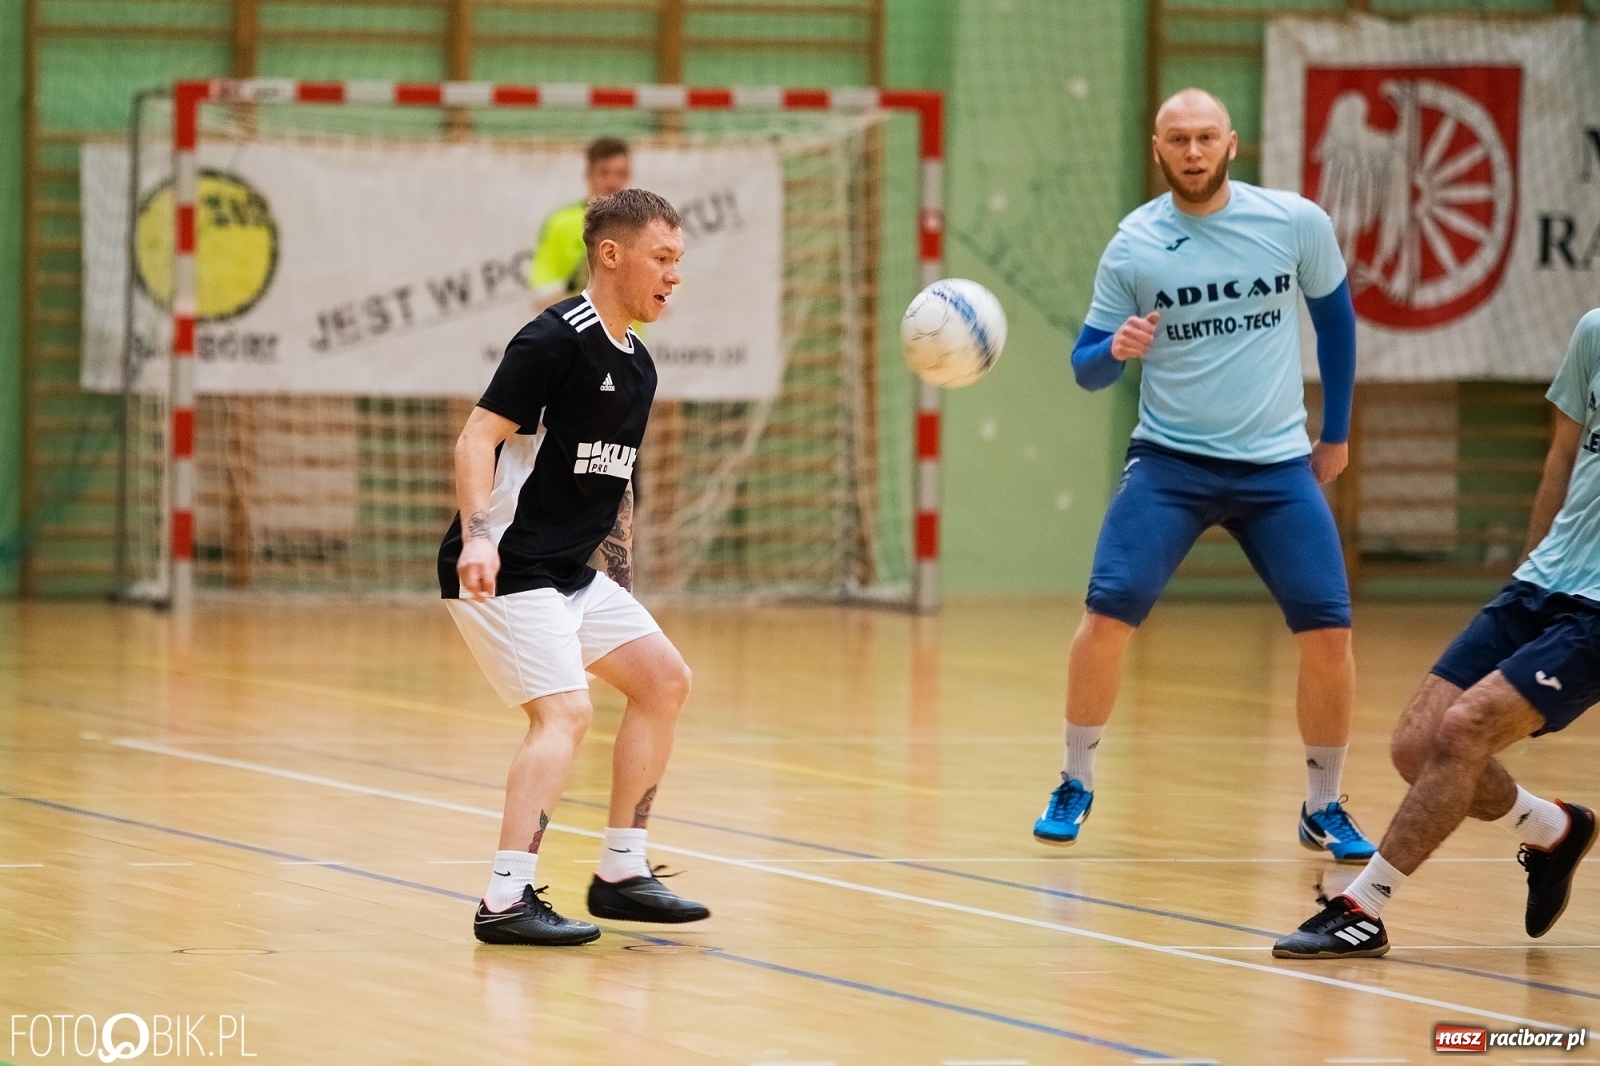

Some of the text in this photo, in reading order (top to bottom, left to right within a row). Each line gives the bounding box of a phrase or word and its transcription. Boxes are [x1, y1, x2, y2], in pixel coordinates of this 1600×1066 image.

[1154, 274, 1291, 310] ADICAR
[309, 283, 413, 352] JEST
[425, 269, 472, 317] W
[1166, 308, 1281, 342] ELEKTRO-TECH
